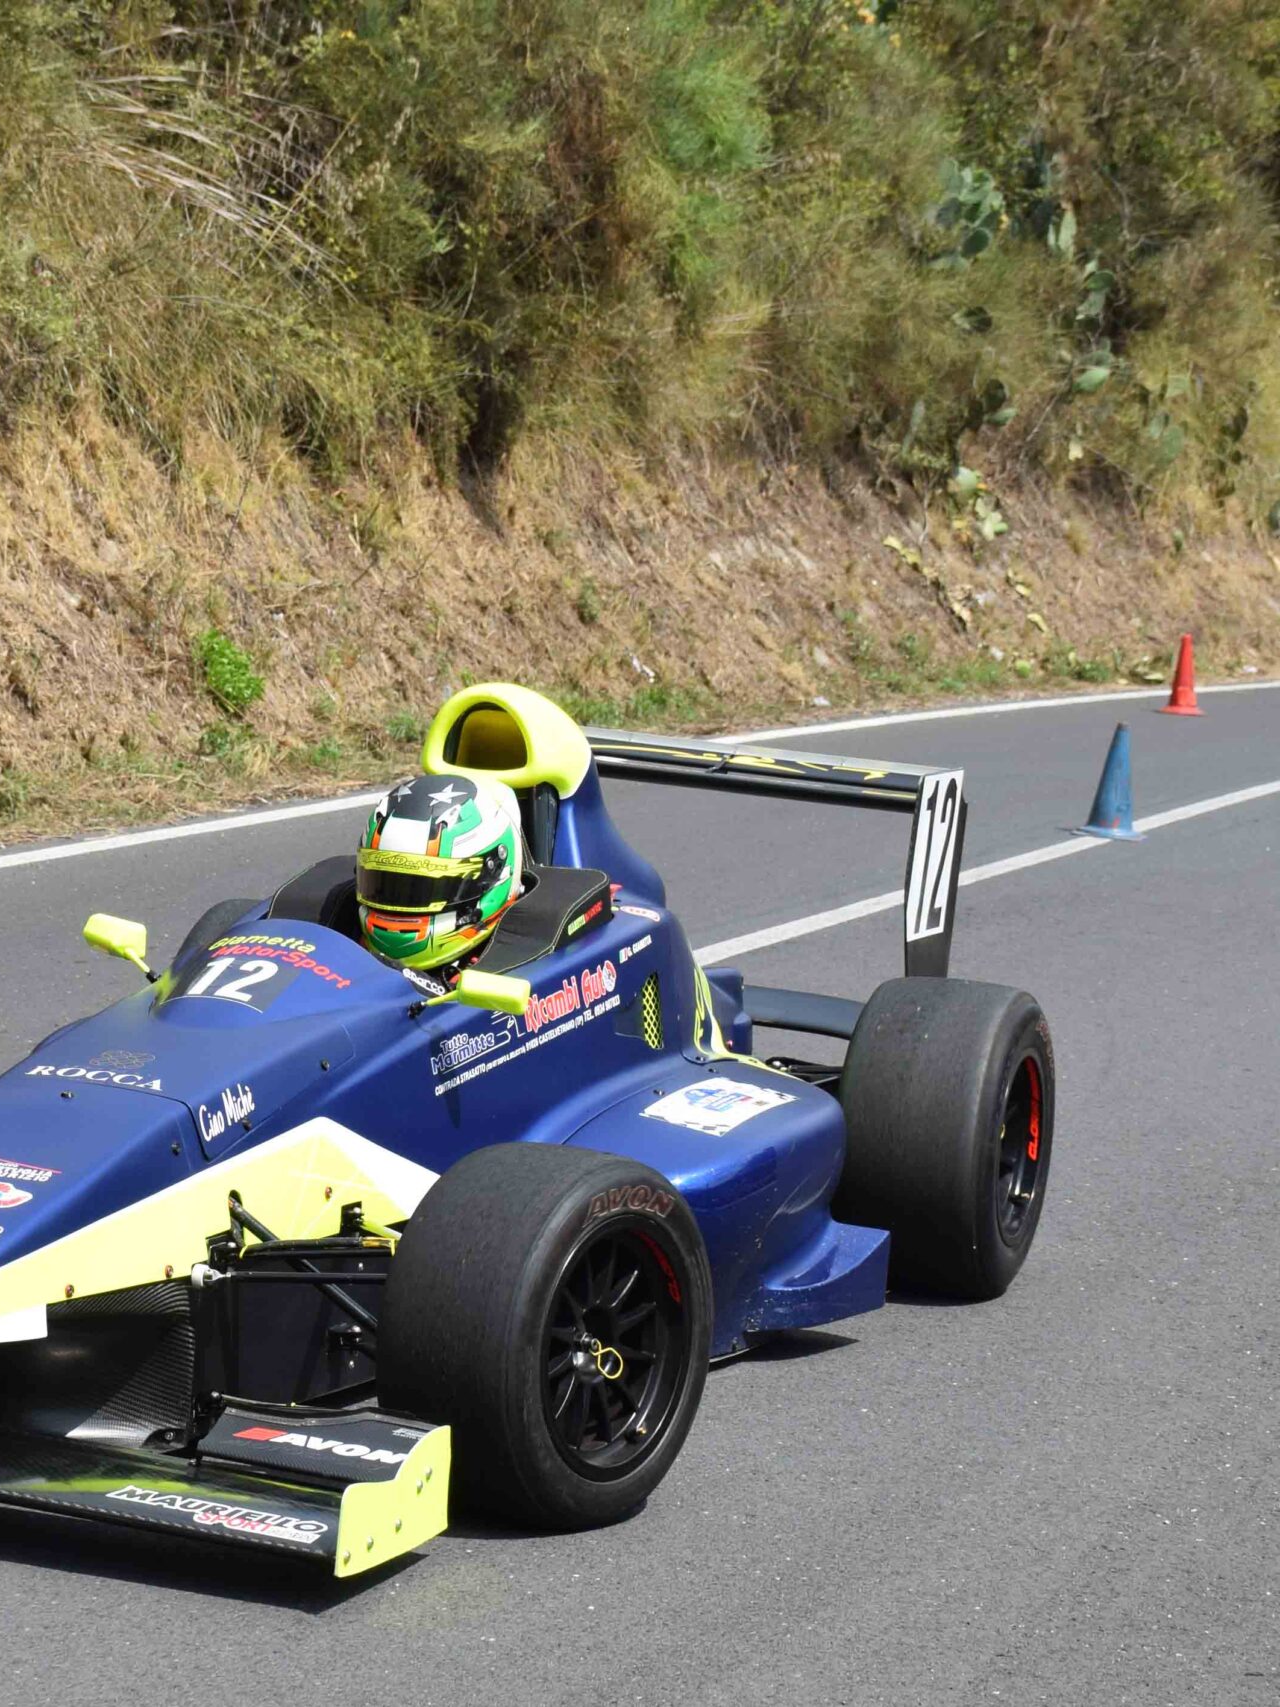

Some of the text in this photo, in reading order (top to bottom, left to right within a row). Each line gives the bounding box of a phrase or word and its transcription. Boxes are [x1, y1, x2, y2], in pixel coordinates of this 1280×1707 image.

[913, 777, 958, 935] 12
[208, 935, 316, 953] Giametta
[186, 957, 279, 1002] 12
[212, 945, 351, 989] MotorSport
[524, 960, 617, 1034] Ricambi Auto
[431, 1032, 495, 1075] Marmitte
[440, 1033, 469, 1054] Tutto
[24, 1065, 163, 1091] ROCCA
[199, 1105, 225, 1142] Ciao
[581, 1184, 675, 1228] AVON
[269, 1432, 409, 1464] AVON
[107, 1485, 328, 1534] MAURIELLO
[195, 1511, 273, 1533] SPORT
